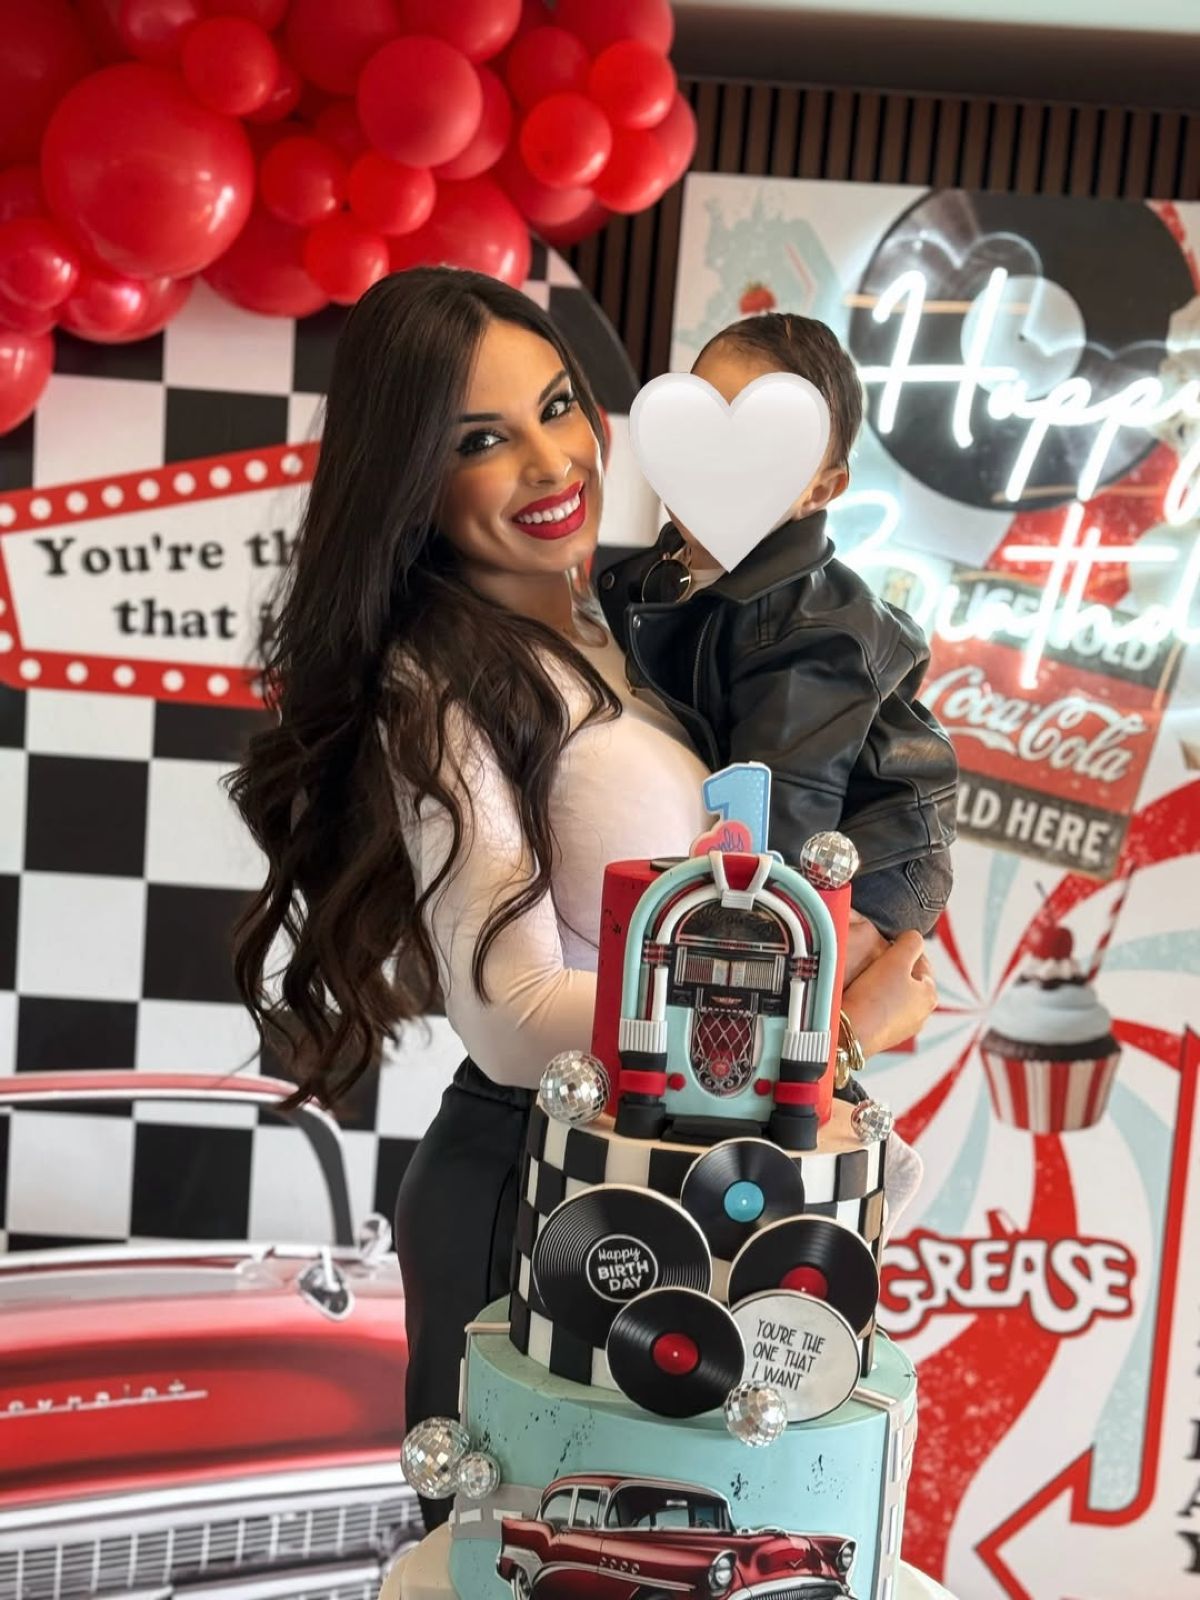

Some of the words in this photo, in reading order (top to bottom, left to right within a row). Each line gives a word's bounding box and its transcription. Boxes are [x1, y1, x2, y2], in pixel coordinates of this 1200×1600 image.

[34, 534, 224, 577] You're
[113, 598, 237, 640] that
[1005, 796, 1111, 862] HERE
[598, 1247, 641, 1263] Happy
[598, 1259, 649, 1280] BIRTH
[609, 1275, 642, 1292] DAY
[875, 1238, 1134, 1335] GREASE
[752, 1341, 779, 1362] ONE
[784, 1349, 816, 1373] THAT
[801, 1331, 826, 1355] THE
[751, 1361, 759, 1379] I
[763, 1365, 804, 1391] WANT
